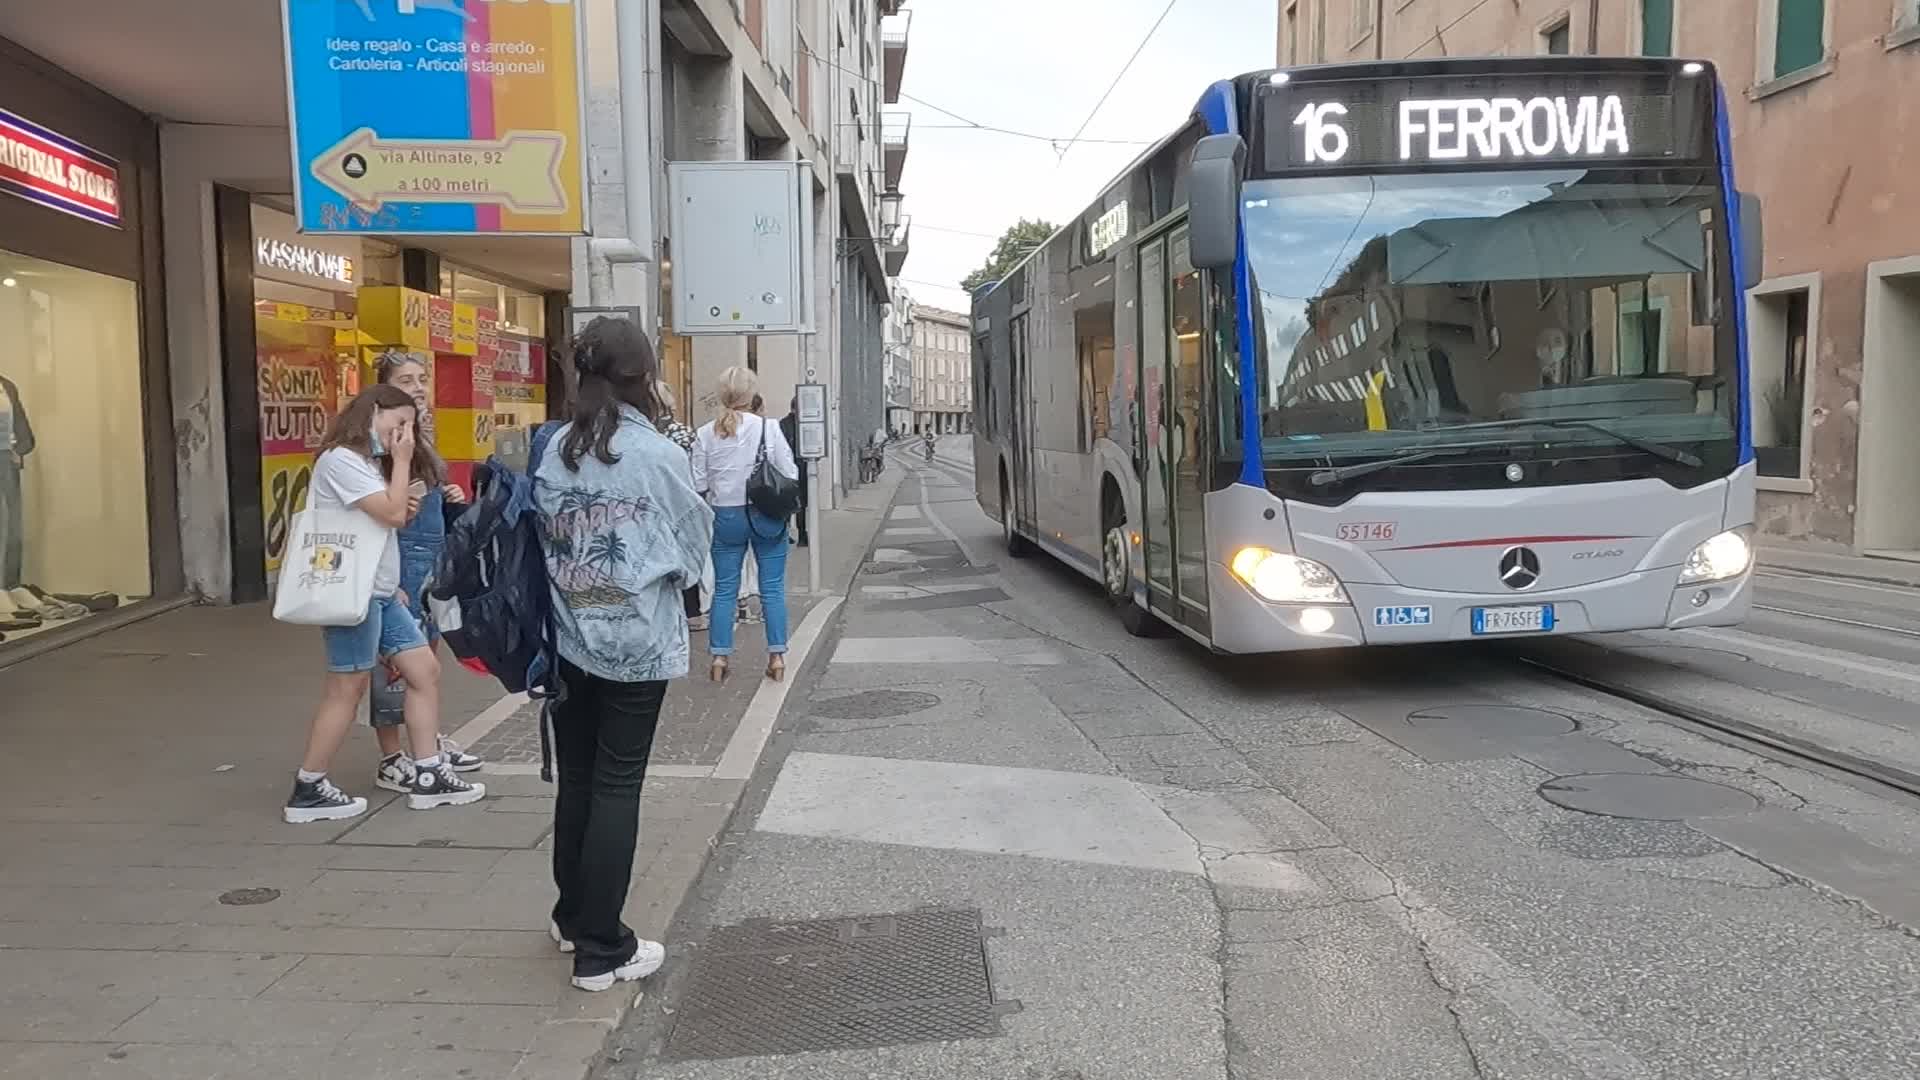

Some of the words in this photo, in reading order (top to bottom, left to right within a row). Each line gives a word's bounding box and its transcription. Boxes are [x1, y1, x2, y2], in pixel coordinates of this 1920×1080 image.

[327, 38, 360, 52] Idee
[364, 38, 412, 55] regalo
[426, 38, 465, 53] Casa
[471, 42, 480, 53] e
[486, 40, 535, 54] arredo
[329, 56, 402, 71] Cartoleria
[417, 57, 467, 72] Articoli
[472, 59, 545, 75] stagionali
[1293, 101, 1349, 162] 16
[1399, 94, 1629, 160] FERROVIA
[381, 151, 404, 164] via
[409, 151, 478, 165] Altinate,
[484, 151, 503, 164] 92
[68, 163, 116, 205] STORE
[398, 179, 407, 191] a
[412, 178, 440, 191] 100
[446, 178, 489, 191] metri
[257, 236, 342, 281] KASANOVA
[263, 404, 326, 437] TUTTO
